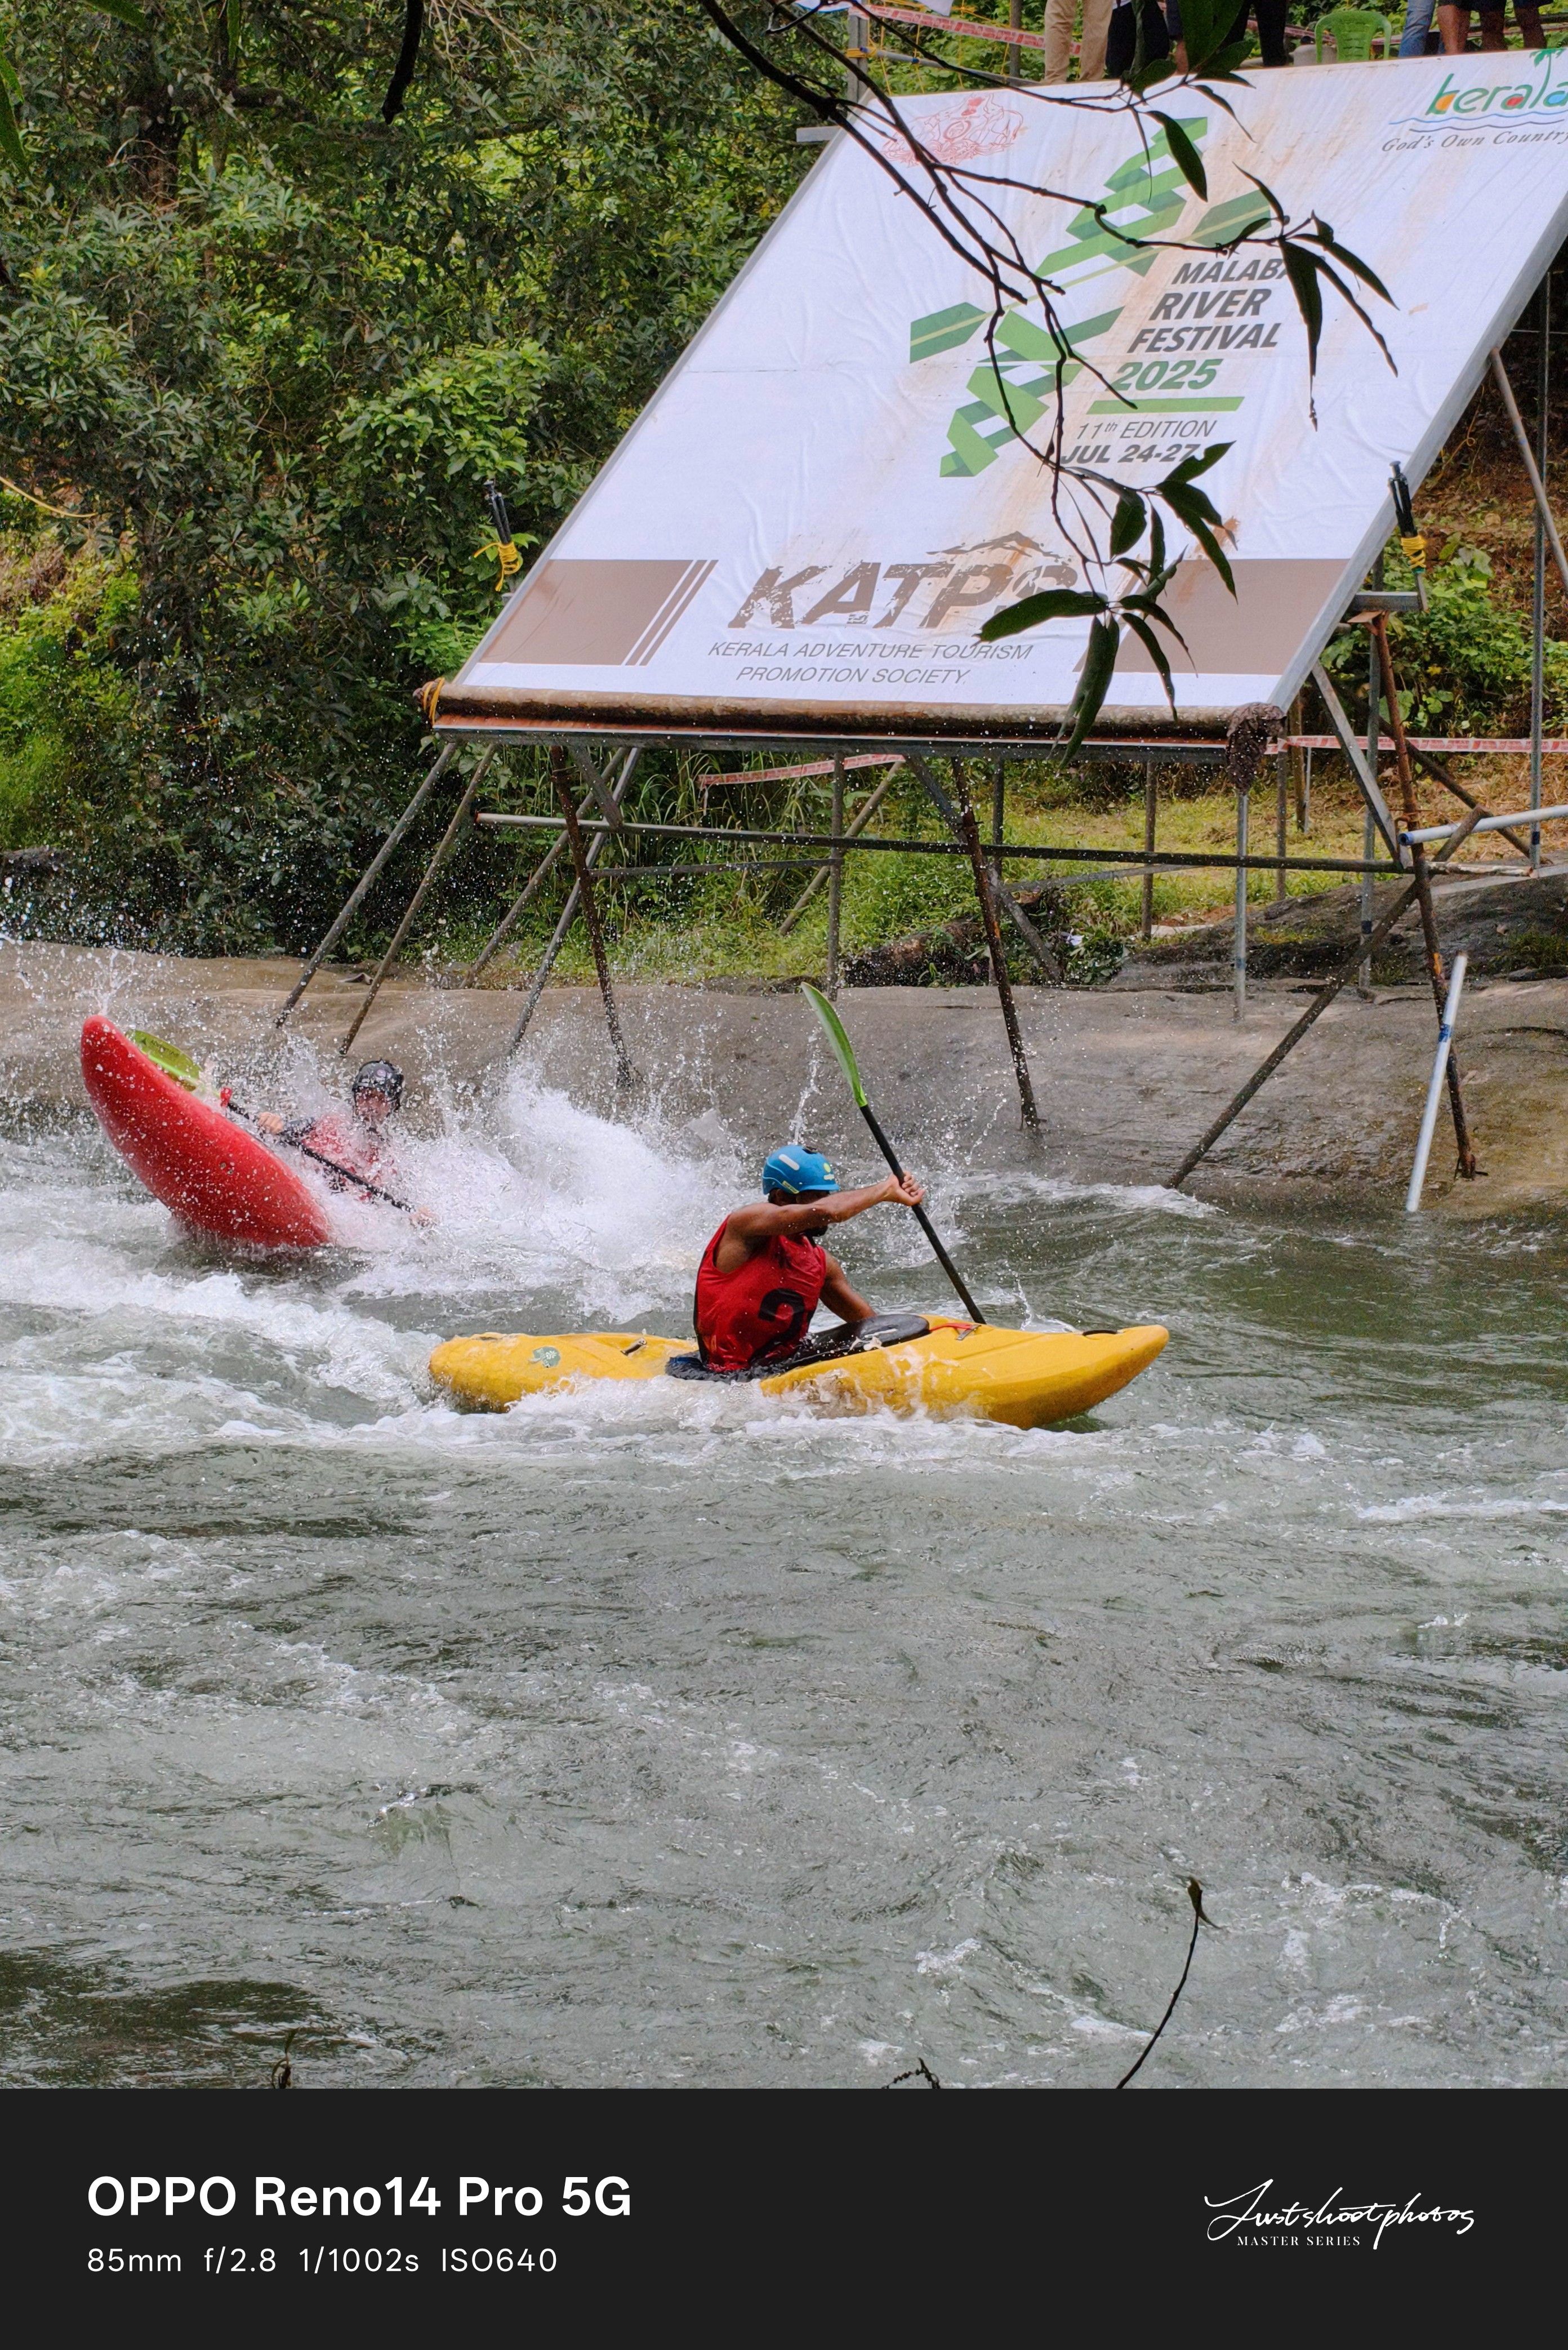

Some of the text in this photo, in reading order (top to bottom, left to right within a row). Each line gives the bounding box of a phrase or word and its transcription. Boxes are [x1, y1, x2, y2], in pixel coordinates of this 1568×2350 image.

[1382, 136, 1434, 152] God's
[1441, 134, 1485, 148] Own
[1171, 257, 1325, 285] MALAB
[1148, 288, 1272, 322] RIVER
[1126, 322, 1282, 354] FESTIVAL
[1105, 358, 1224, 392] 2025
[1077, 420, 1218, 439] 11th EDITION
[1061, 443, 1201, 464] JUL 24-27
[708, 642, 1034, 660] KERALA ADVENTURE TOURISM
[736, 667, 970, 684] PROMOTION SOCIETY
